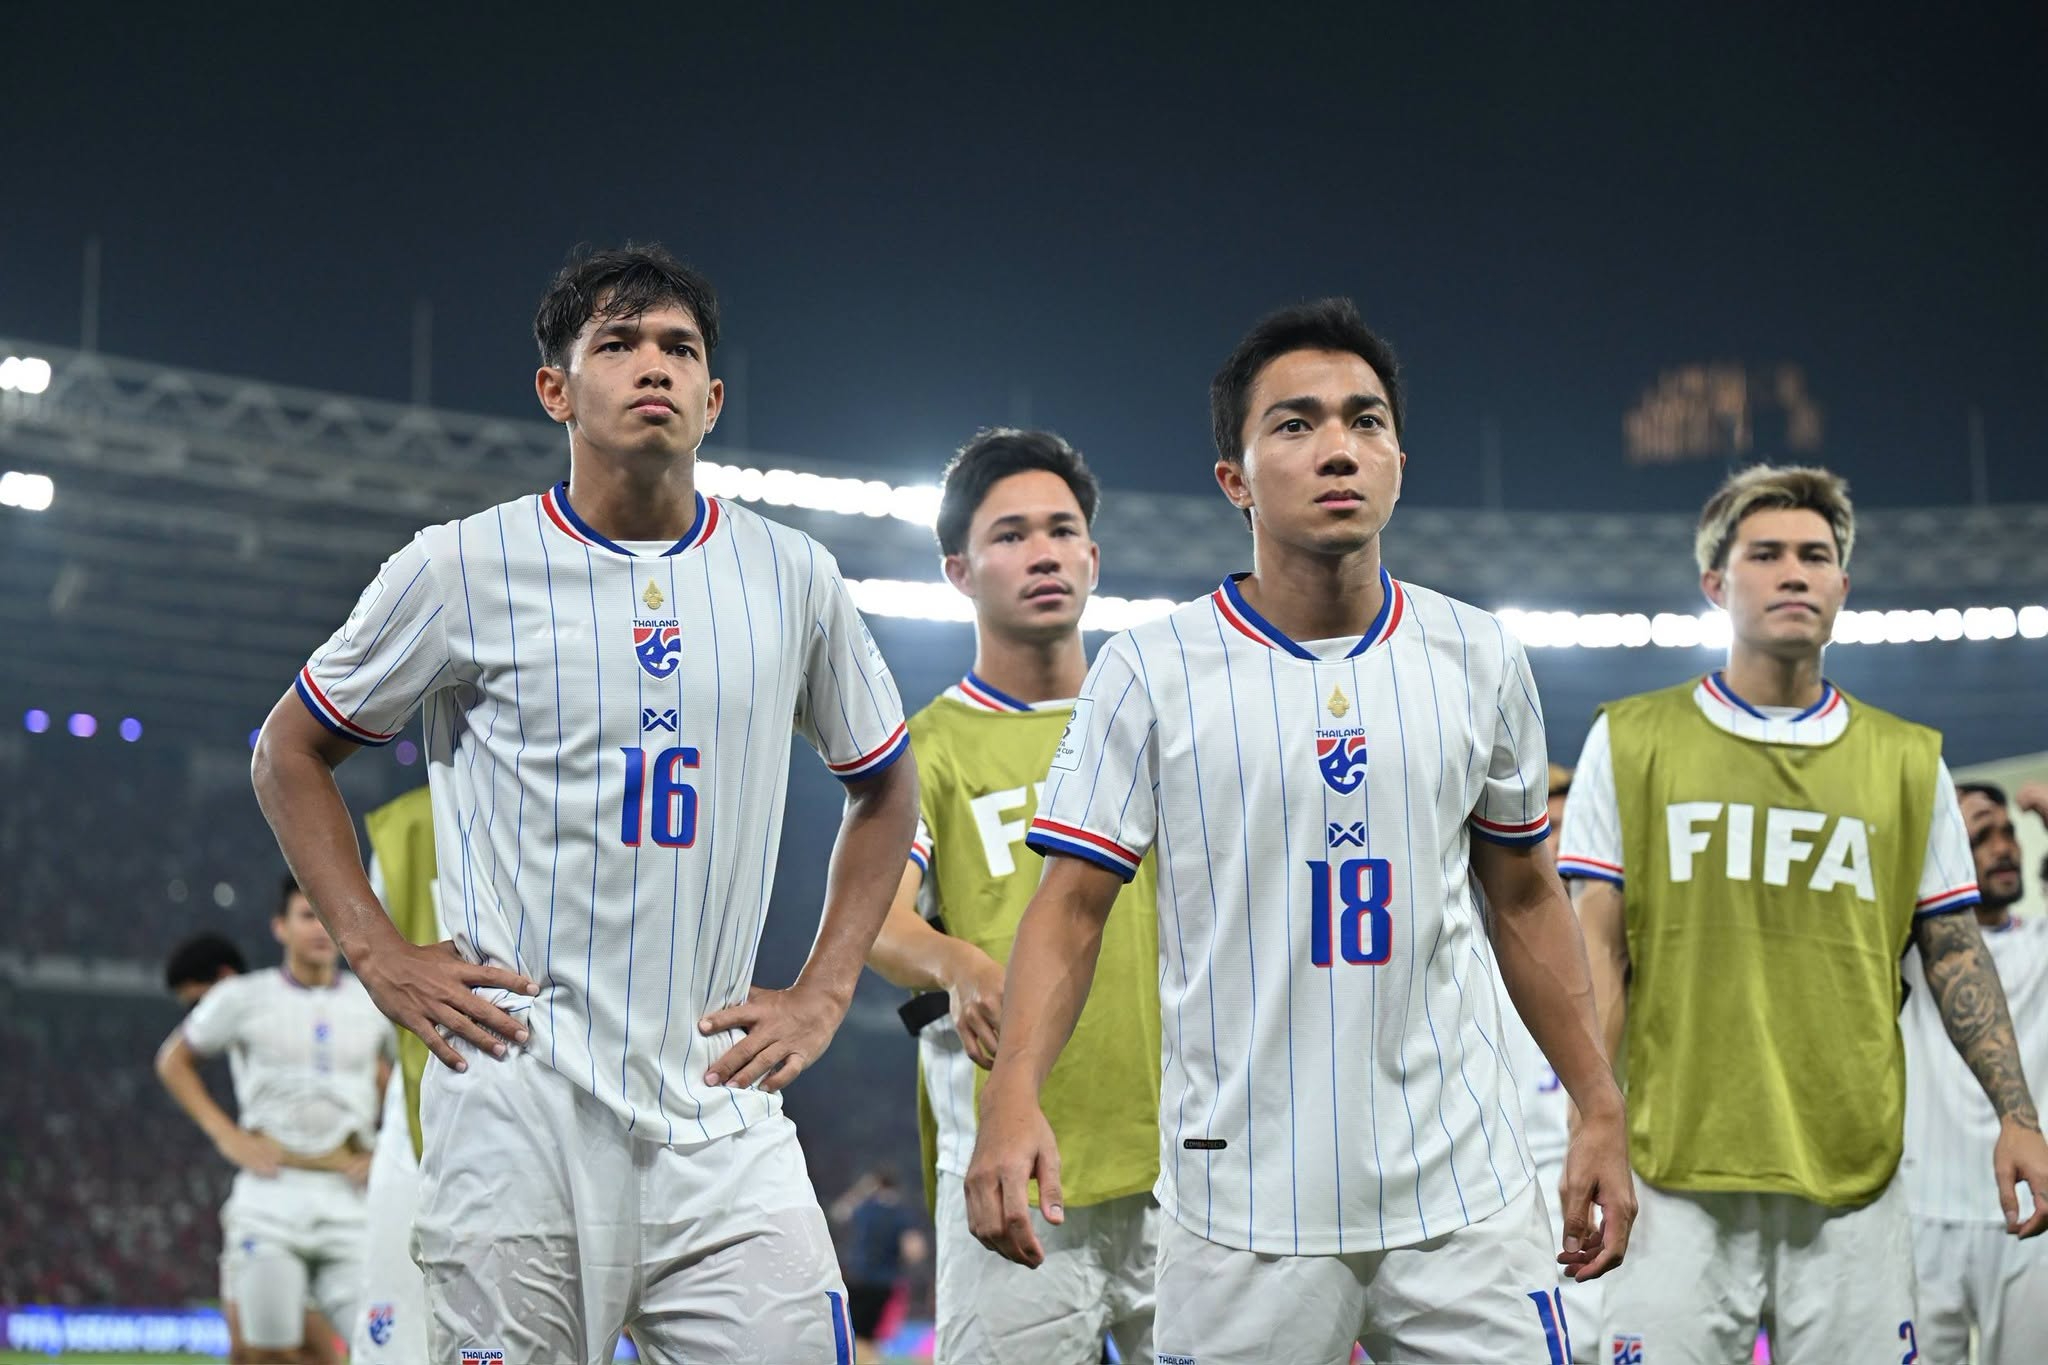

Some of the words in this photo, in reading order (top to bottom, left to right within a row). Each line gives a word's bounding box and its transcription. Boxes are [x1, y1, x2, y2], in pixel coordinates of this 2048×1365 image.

[632, 619, 679, 627] THAILAND
[1316, 728, 1365, 738] THAILAND
[620, 747, 700, 849] 16
[969, 786, 1046, 877] F
[1666, 801, 1876, 902] FIFA
[1305, 858, 1393, 968] 18
[461, 1351, 503, 1359] THAILAND
[1527, 1286, 1574, 1365] 1
